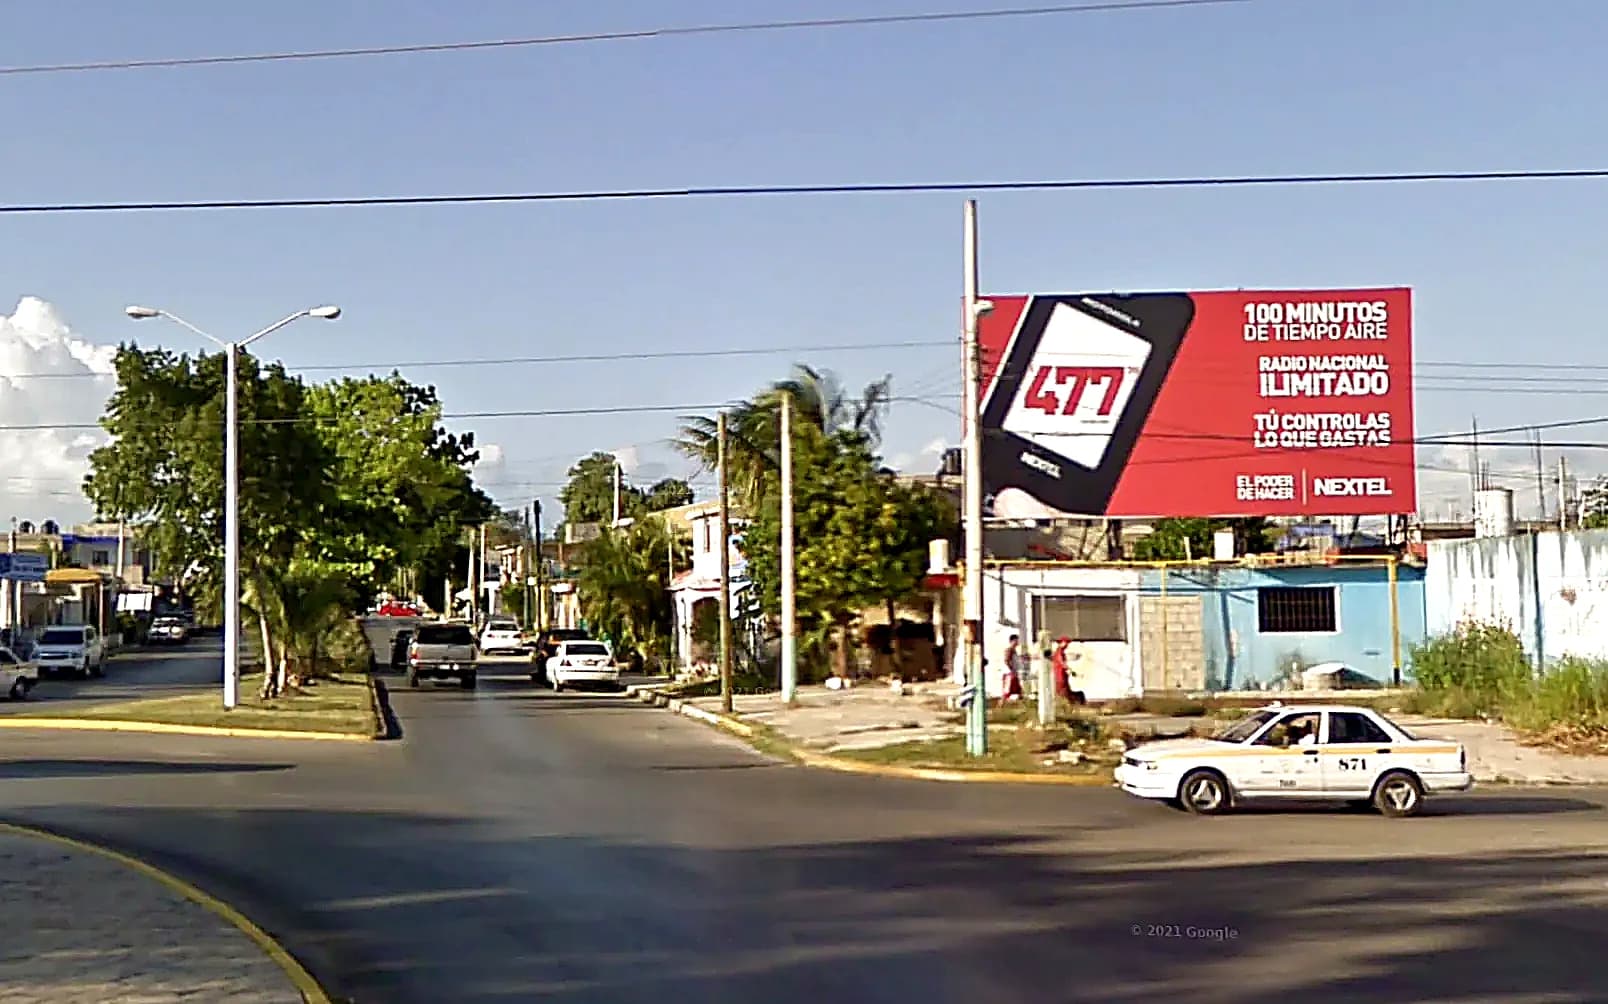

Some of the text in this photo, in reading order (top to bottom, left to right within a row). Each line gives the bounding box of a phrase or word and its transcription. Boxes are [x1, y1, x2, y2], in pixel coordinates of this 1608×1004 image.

[1243, 301, 1388, 324] 100 MINUTOS
[1243, 322, 1388, 341] DE TIEMPO AIRE
[1259, 354, 1389, 371] RADIO NACIONAL
[1023, 365, 1125, 416] 477
[1259, 372, 1389, 397] ILIMITADO
[1253, 407, 1390, 430] TÚ CONTROLAS
[1254, 430, 1391, 448] LO QUE GASTAS
[1236, 475, 1293, 487] EL PODER
[1314, 478, 1392, 496] NEXTEL
[1236, 487, 1294, 500] DE HACER
[1338, 757, 1367, 771] 871
